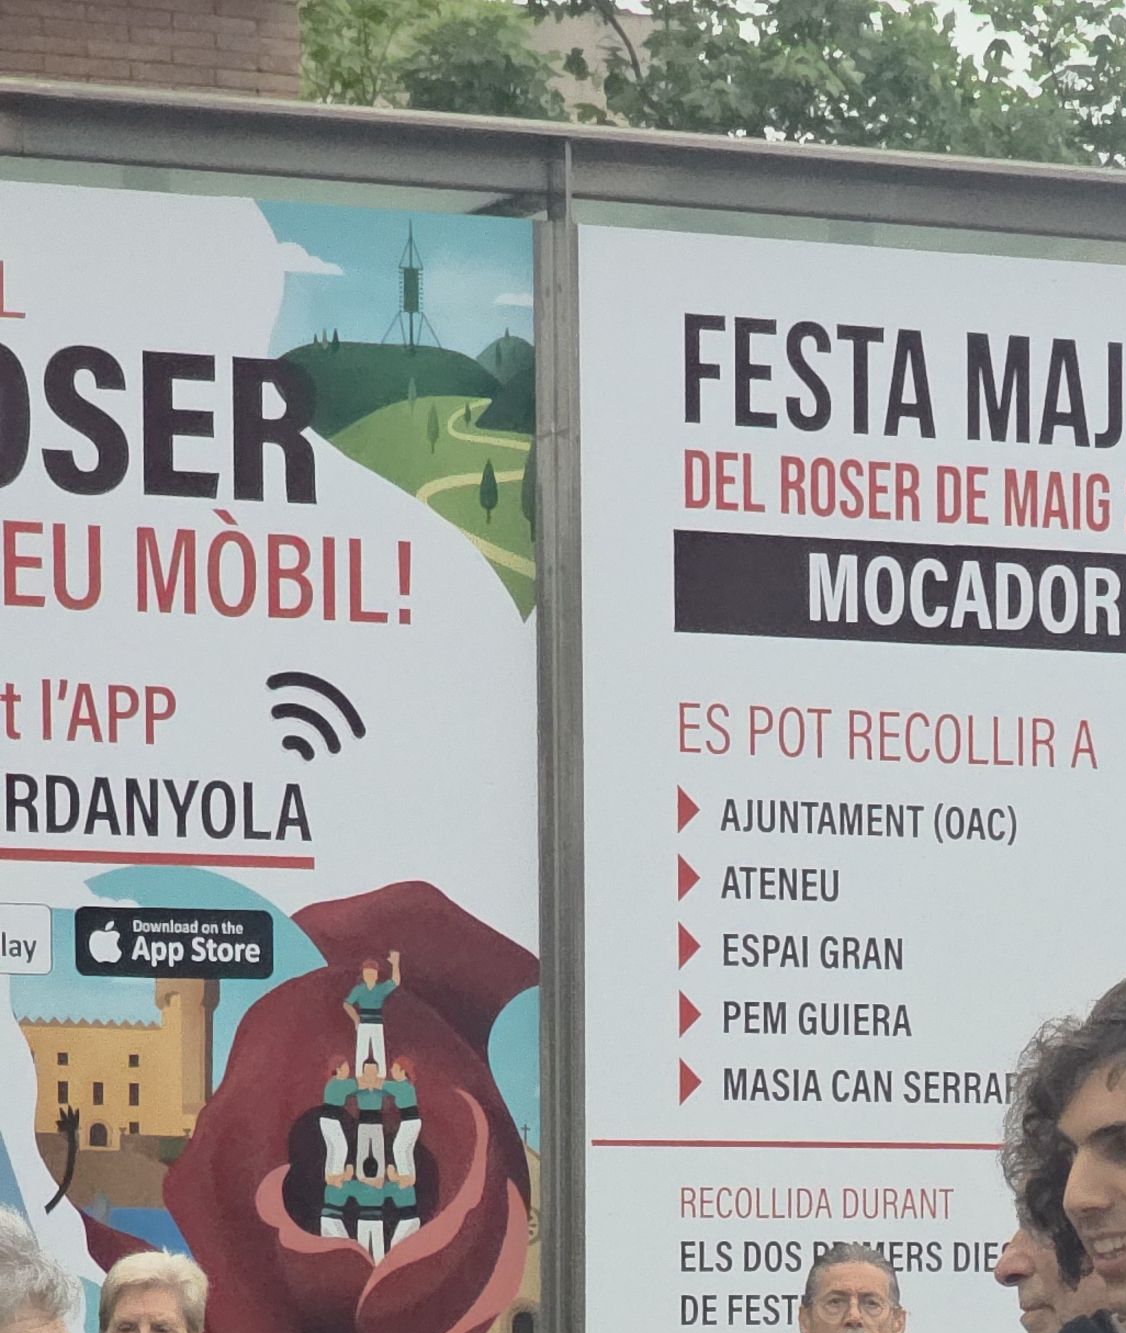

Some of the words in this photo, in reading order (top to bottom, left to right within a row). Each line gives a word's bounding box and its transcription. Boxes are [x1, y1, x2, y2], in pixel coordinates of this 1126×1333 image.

[684, 312, 936, 439] FESTA
[684, 448, 766, 513] DEL
[780, 455, 921, 522] ROSER
[936, 465, 989, 526] DE
[1004, 468, 1110, 532] MAIG
[136, 508, 413, 625] MÒBIL!
[808, 552, 1121, 636] MOCADOR
[42, 679, 177, 745] l'APP
[679, 702, 731, 755] ES
[749, 705, 832, 759] POT
[848, 709, 1055, 768] RECOLLIR
[1070, 719, 1098, 770] A
[720, 798, 925, 838] AJUNTAMENT
[934, 802, 1017, 843] (OAC)
[720, 865, 839, 902] ATENEU
[132, 919, 198, 934] Download
[201, 922, 219, 934] on
[221, 920, 244, 935] the
[131, 936, 185, 968] App
[191, 936, 261, 963] Store
[722, 933, 809, 968] ESPAI
[820, 935, 903, 971] GRAN
[723, 1000, 787, 1035] PEM
[798, 1001, 912, 1037] GUIERA
[723, 1067, 823, 1102] MASIA
[831, 1069, 892, 1103] CAN
[680, 1186, 833, 1219] RECOLLIDA
[842, 1187, 954, 1220] DURANT
[680, 1240, 733, 1273] ELS
[743, 1240, 802, 1273] DOS
[953, 1242, 1010, 1272] DIE
[680, 1294, 718, 1326] DE
[727, 1295, 806, 1326] FEST
